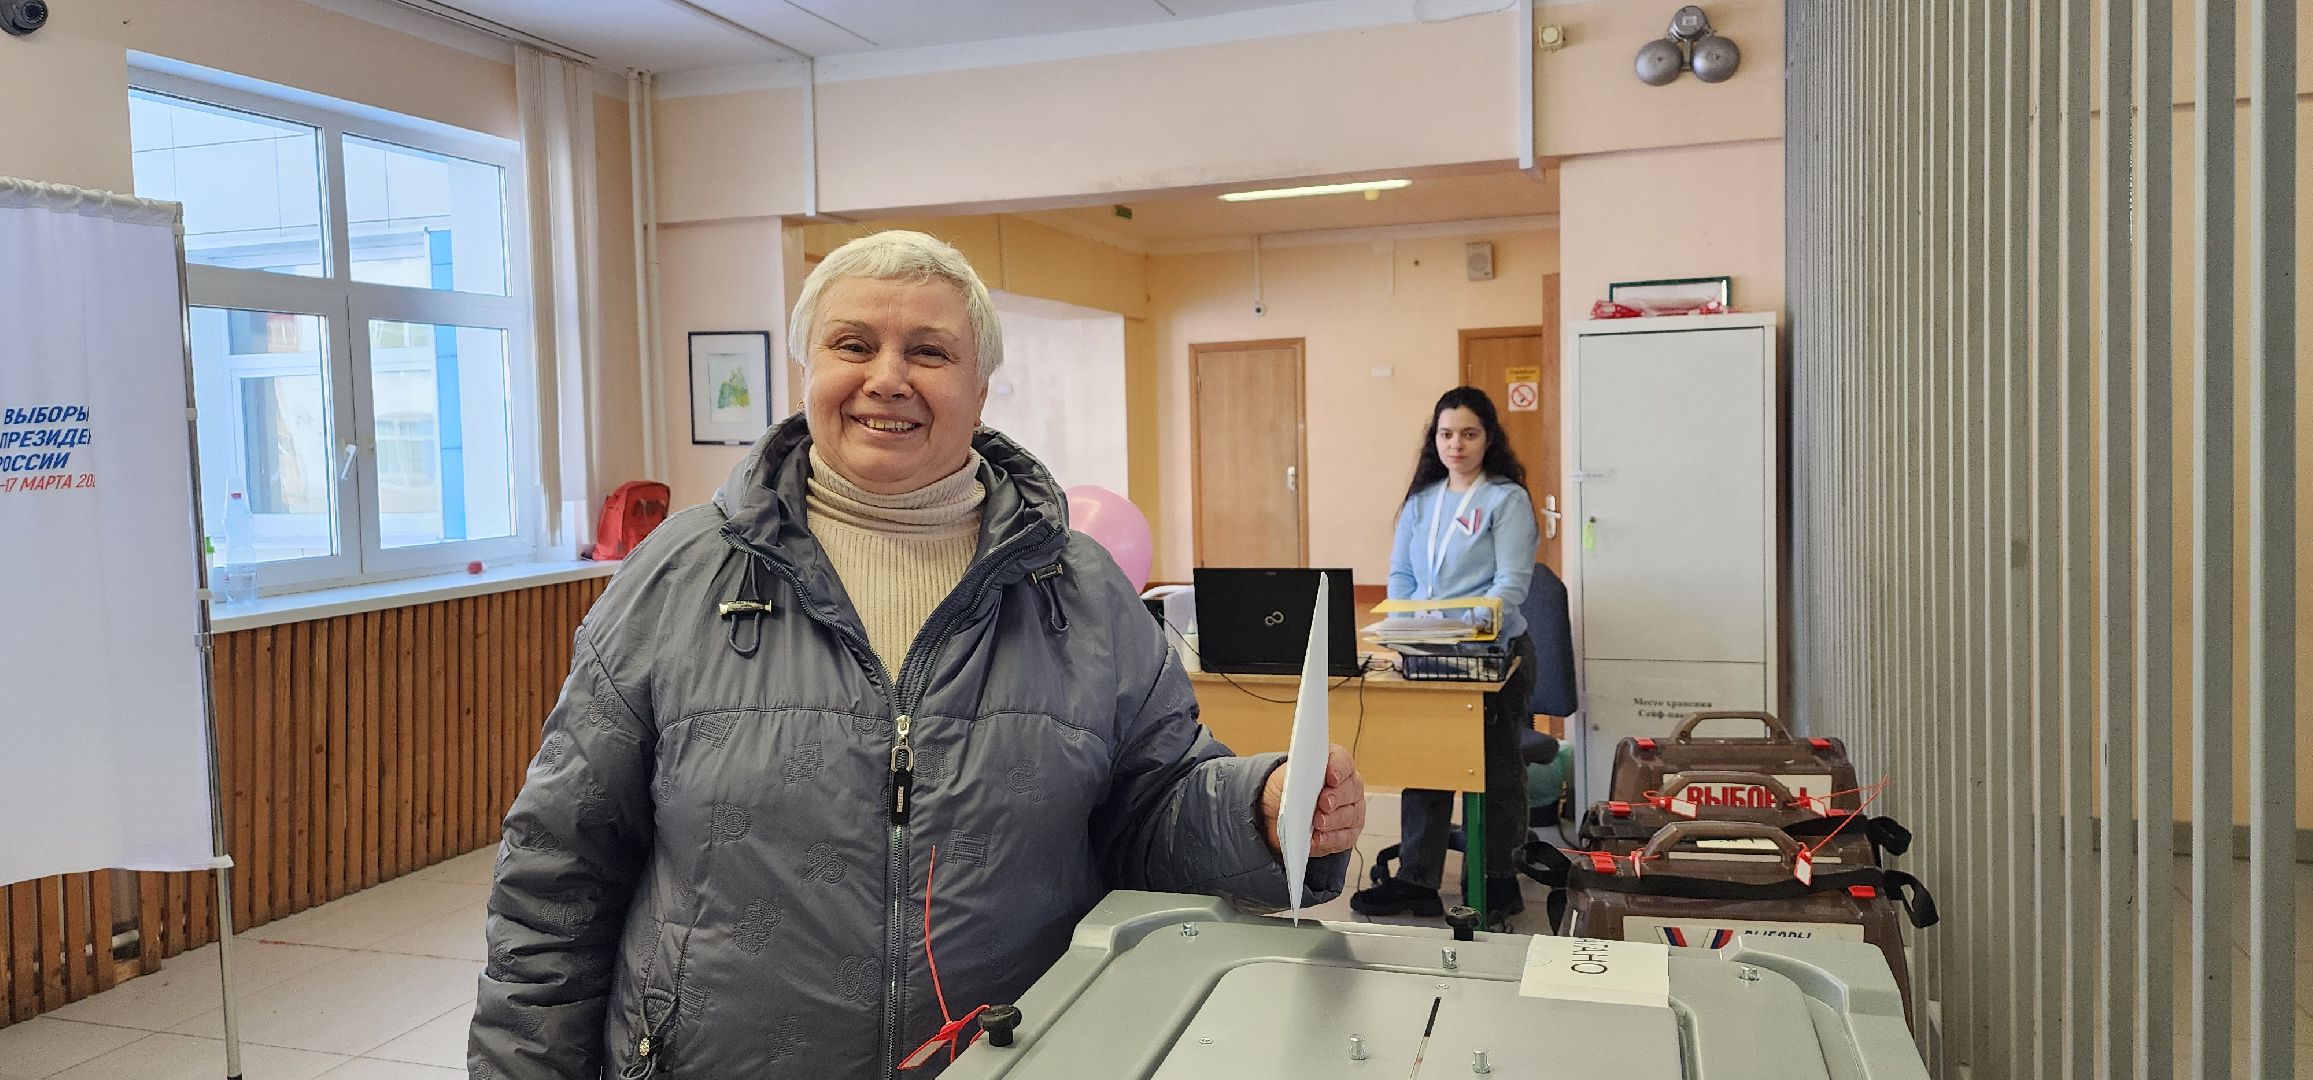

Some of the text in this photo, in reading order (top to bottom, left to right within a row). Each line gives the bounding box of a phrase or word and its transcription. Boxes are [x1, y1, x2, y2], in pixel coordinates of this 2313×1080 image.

[4, 405, 90, 425] ВЫБОРЫ
[19, 474, 73, 492] МАРТА
[1686, 785, 1808, 808] ВЫБО
